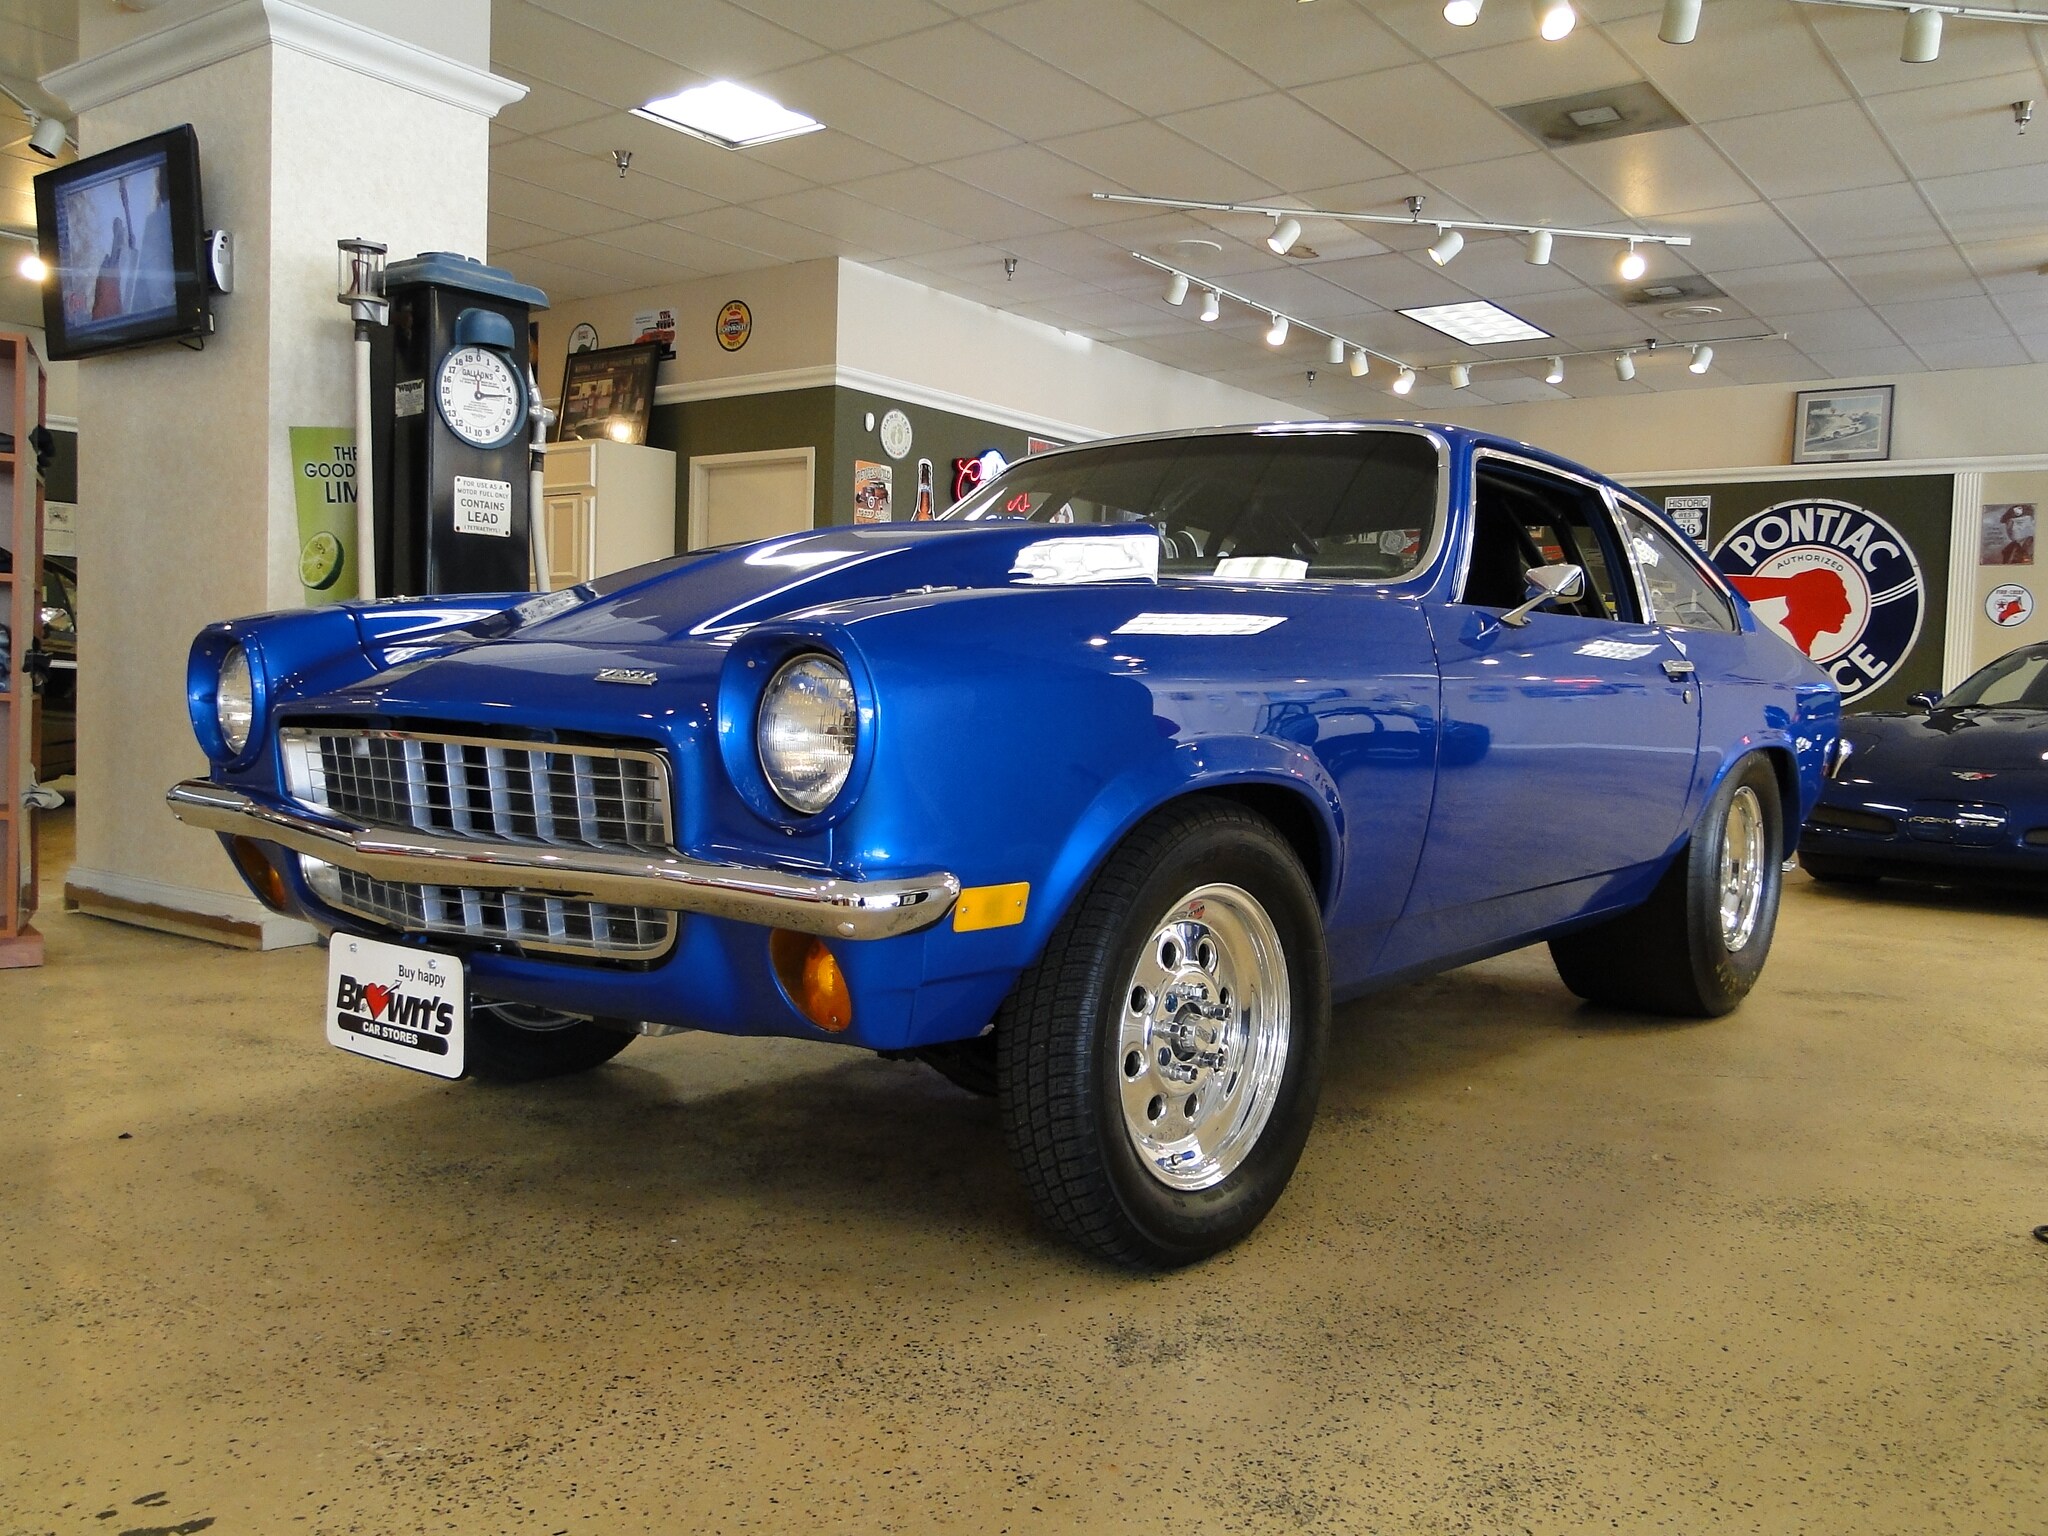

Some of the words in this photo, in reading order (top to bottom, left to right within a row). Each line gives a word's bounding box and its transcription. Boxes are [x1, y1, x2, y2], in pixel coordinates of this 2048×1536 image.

[455, 358, 464, 366] 18
[448, 366, 456, 374] 17
[462, 368, 494, 380] GALLONS
[495, 365, 500, 373] 2
[443, 375, 452, 383] 16
[455, 419, 464, 427] 12
[501, 418, 506, 426] 7
[465, 426, 472, 434] 11
[474, 429, 482, 437] 10
[334, 446, 357, 461] THE
[304, 462, 356, 479] GOOD
[325, 481, 358, 504] LIM
[460, 498, 505, 511] CONTAINS
[1669, 499, 1707, 508] HISTORIC
[468, 511, 499, 524] LEAD
[1729, 507, 1900, 573] PONTIAC
[1777, 553, 1844, 572] AUTHORIZED
[398, 964, 416, 982] Buy
[418, 968, 446, 988] happy
[336, 973, 454, 1035] Brwn's
[362, 1021, 381, 1036] CAR
[382, 1026, 418, 1045] STORES
